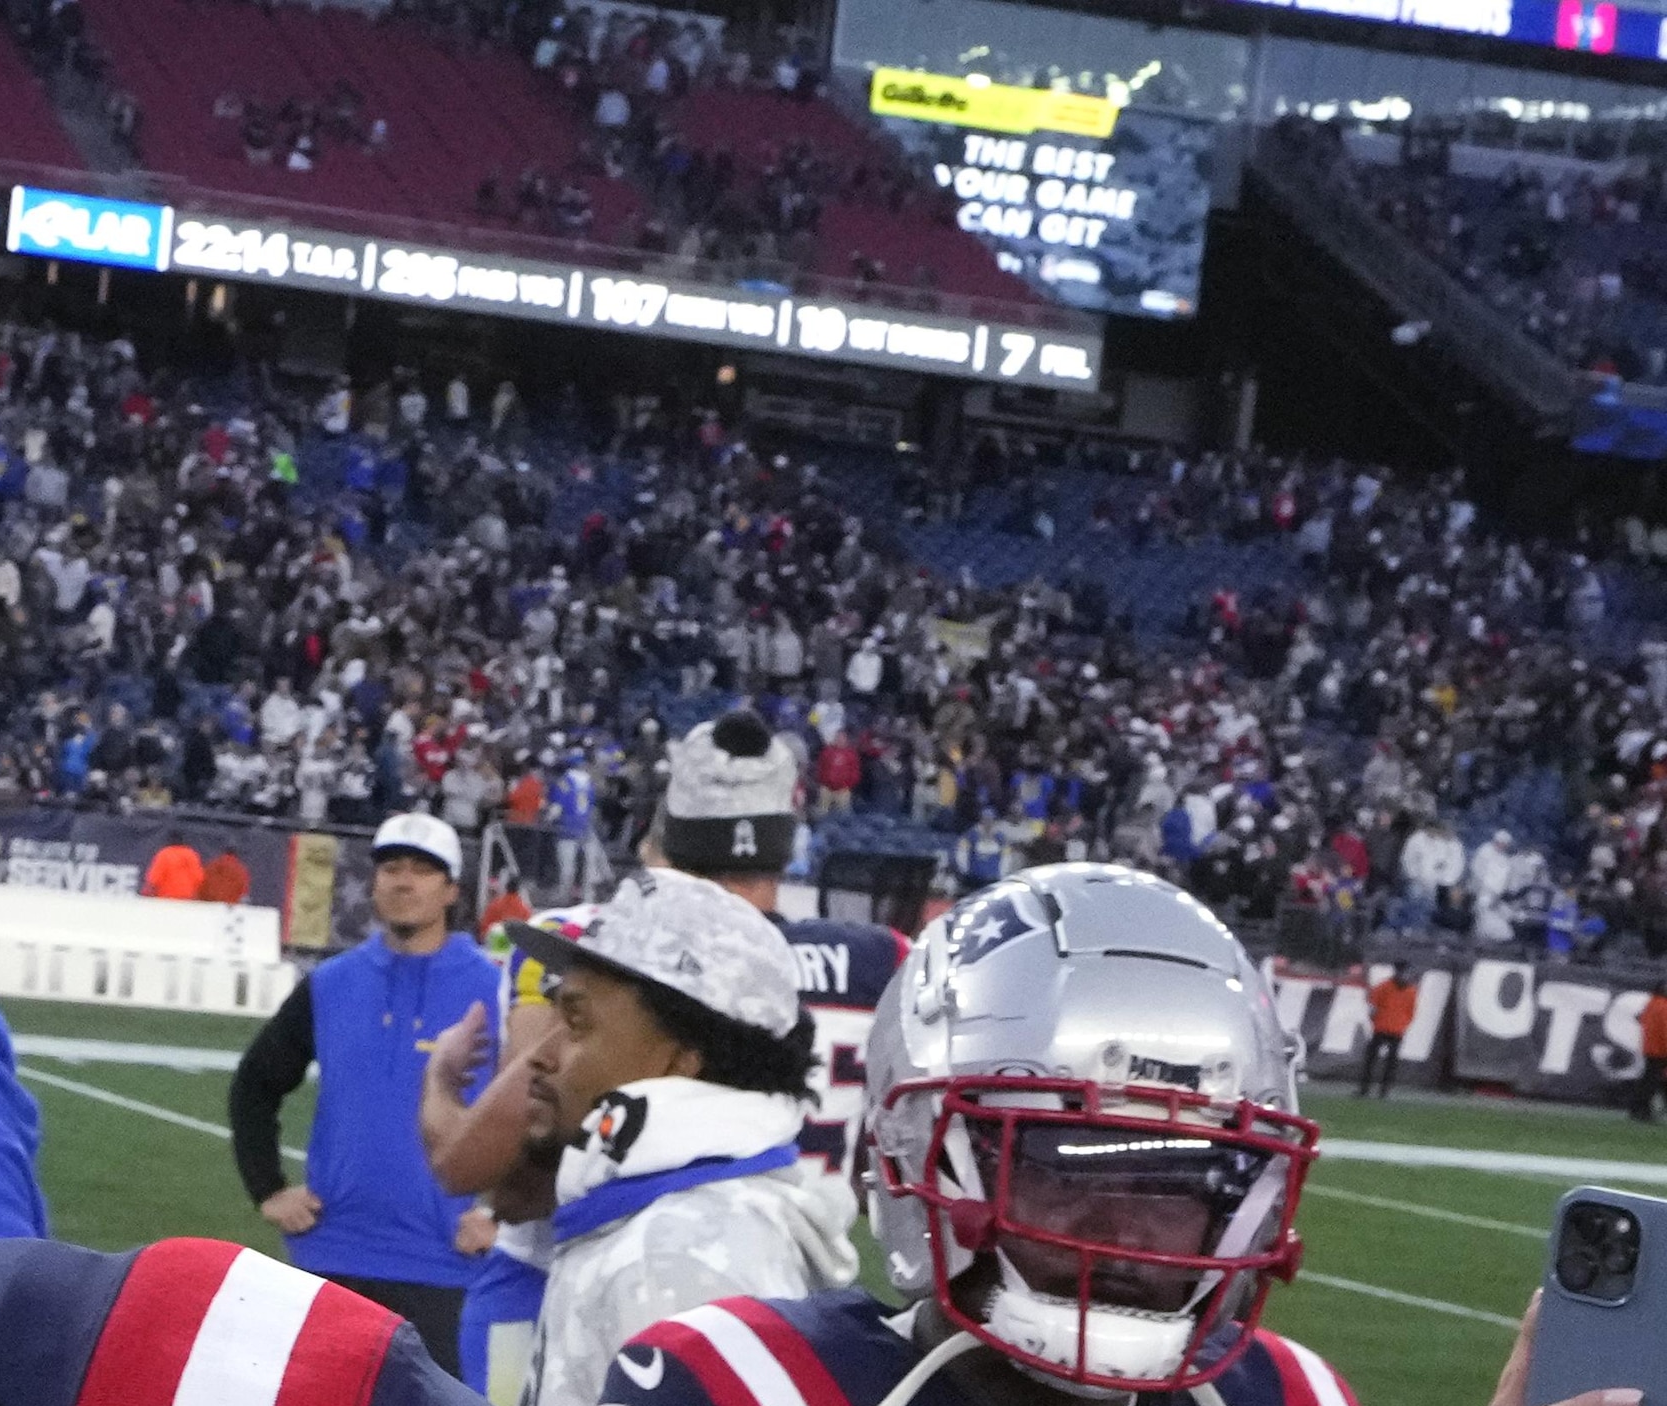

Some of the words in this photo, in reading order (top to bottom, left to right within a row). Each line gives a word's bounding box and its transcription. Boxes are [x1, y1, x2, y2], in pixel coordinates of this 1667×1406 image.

[964, 134, 1028, 171] THE
[1032, 145, 1116, 184] BEST
[1035, 179, 1138, 221] GAME
[72, 208, 152, 258] LAR
[956, 203, 1034, 241] CAN
[1037, 213, 1109, 249] GET
[590, 277, 668, 328] 107
[1000, 332, 1035, 377] 7
[7, 856, 141, 893] SERVICE
